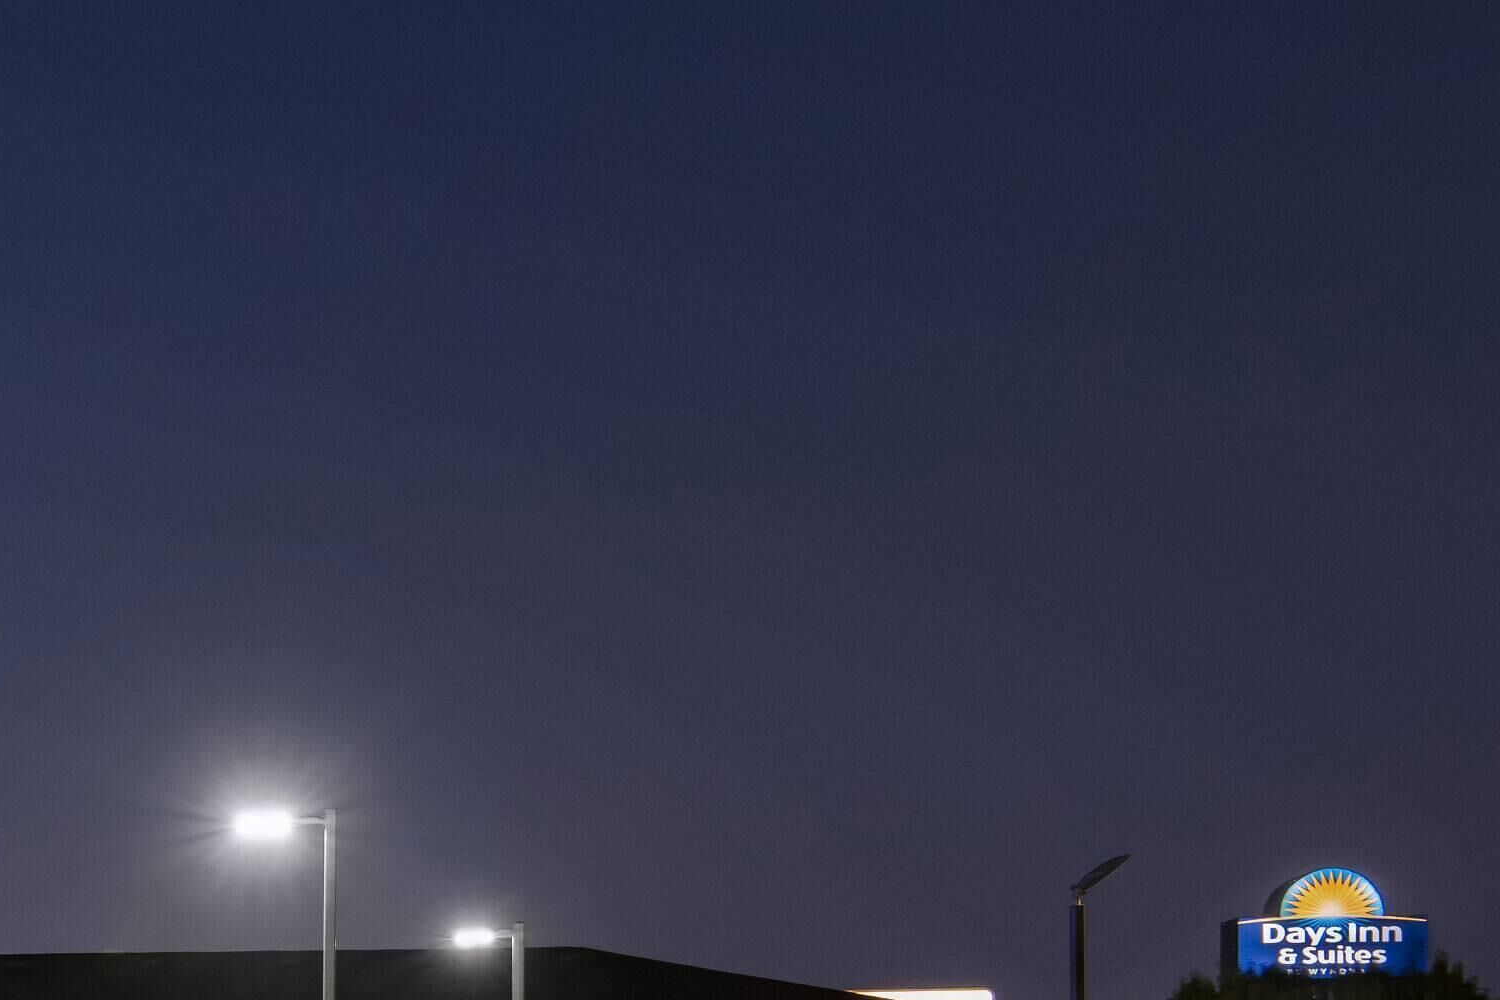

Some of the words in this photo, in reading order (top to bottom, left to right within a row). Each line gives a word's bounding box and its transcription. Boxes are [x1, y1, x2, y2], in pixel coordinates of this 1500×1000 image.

[1262, 923, 1342, 946] Days
[1348, 923, 1403, 943] Inn
[1278, 948, 1297, 965] &
[1302, 945, 1387, 964] Suites
